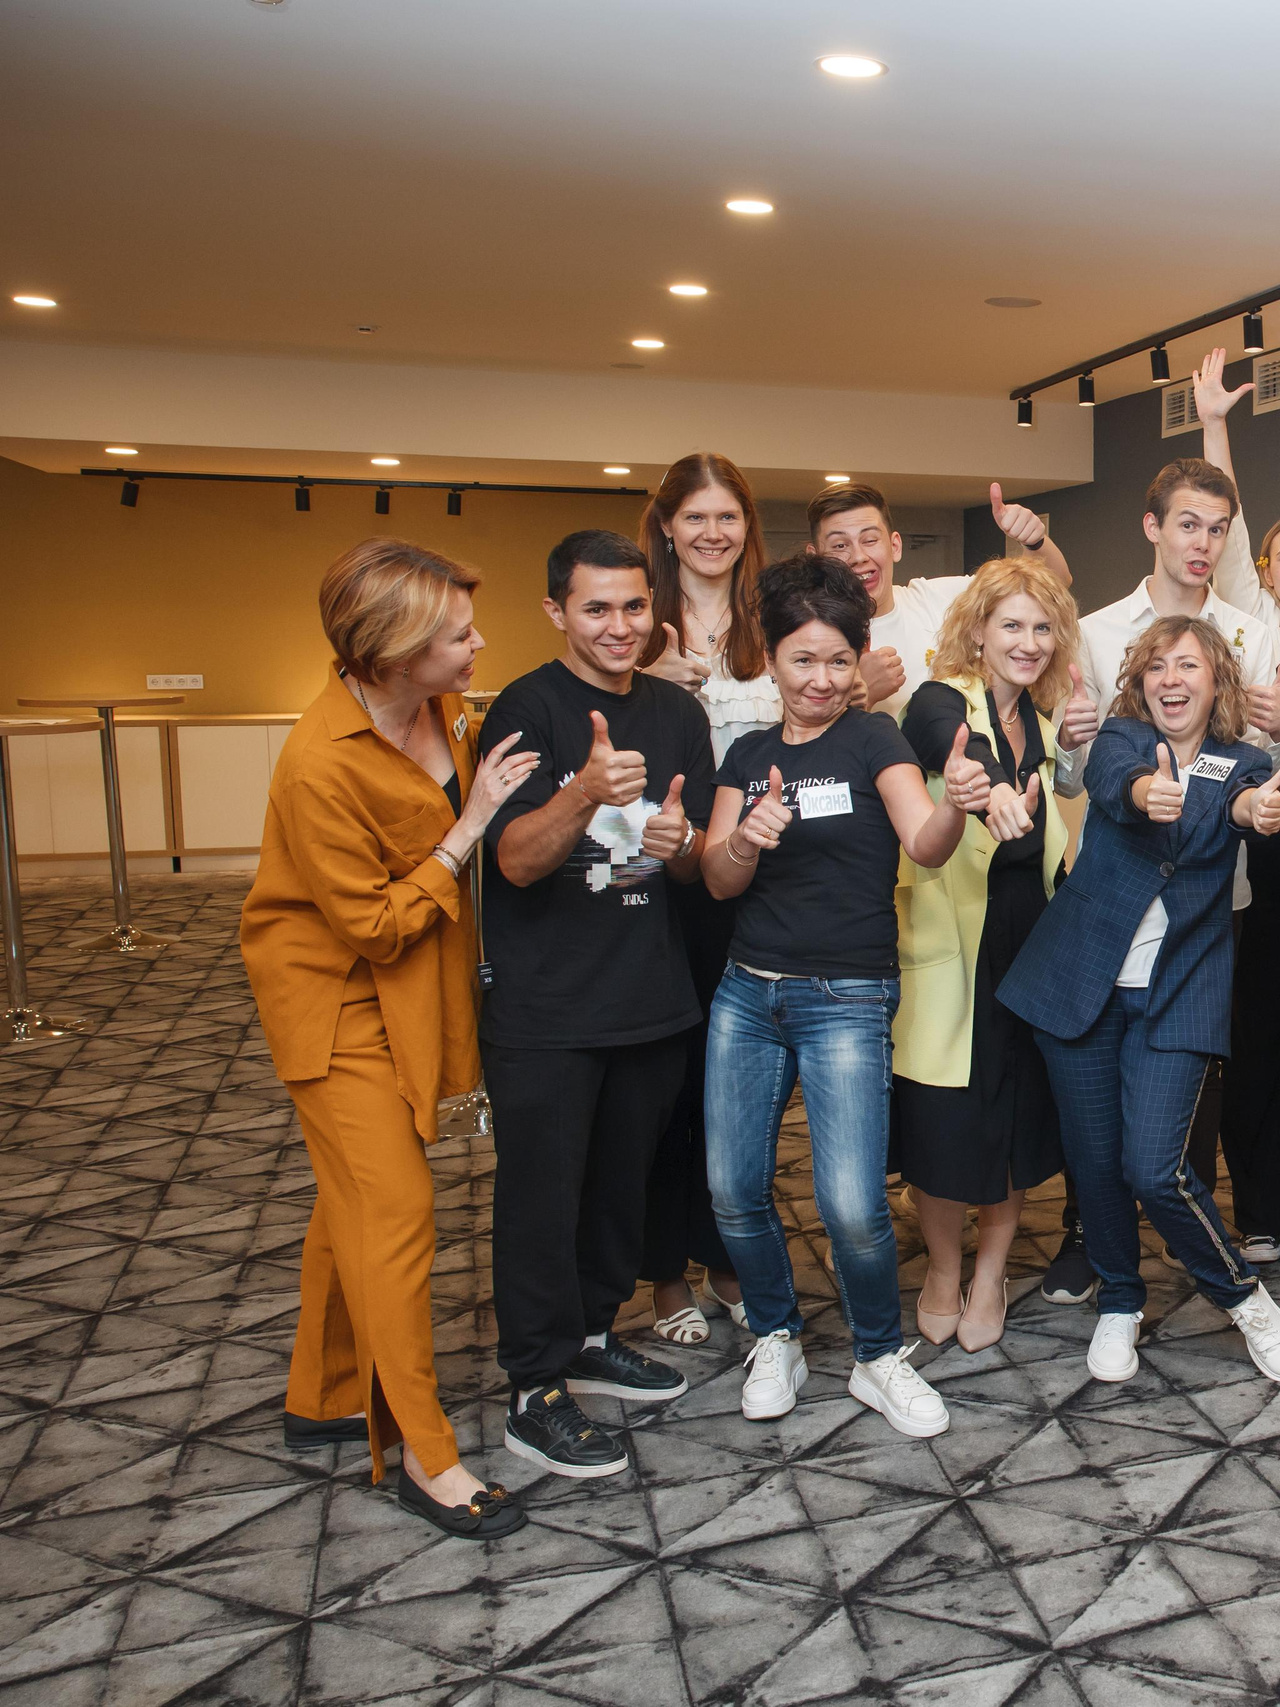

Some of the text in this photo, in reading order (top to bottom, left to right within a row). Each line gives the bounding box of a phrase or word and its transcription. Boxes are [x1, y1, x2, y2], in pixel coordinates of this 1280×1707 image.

[1191, 757, 1232, 778] Галина
[748, 777, 835, 791] EVEYTHING
[801, 791, 849, 815] Оксана
